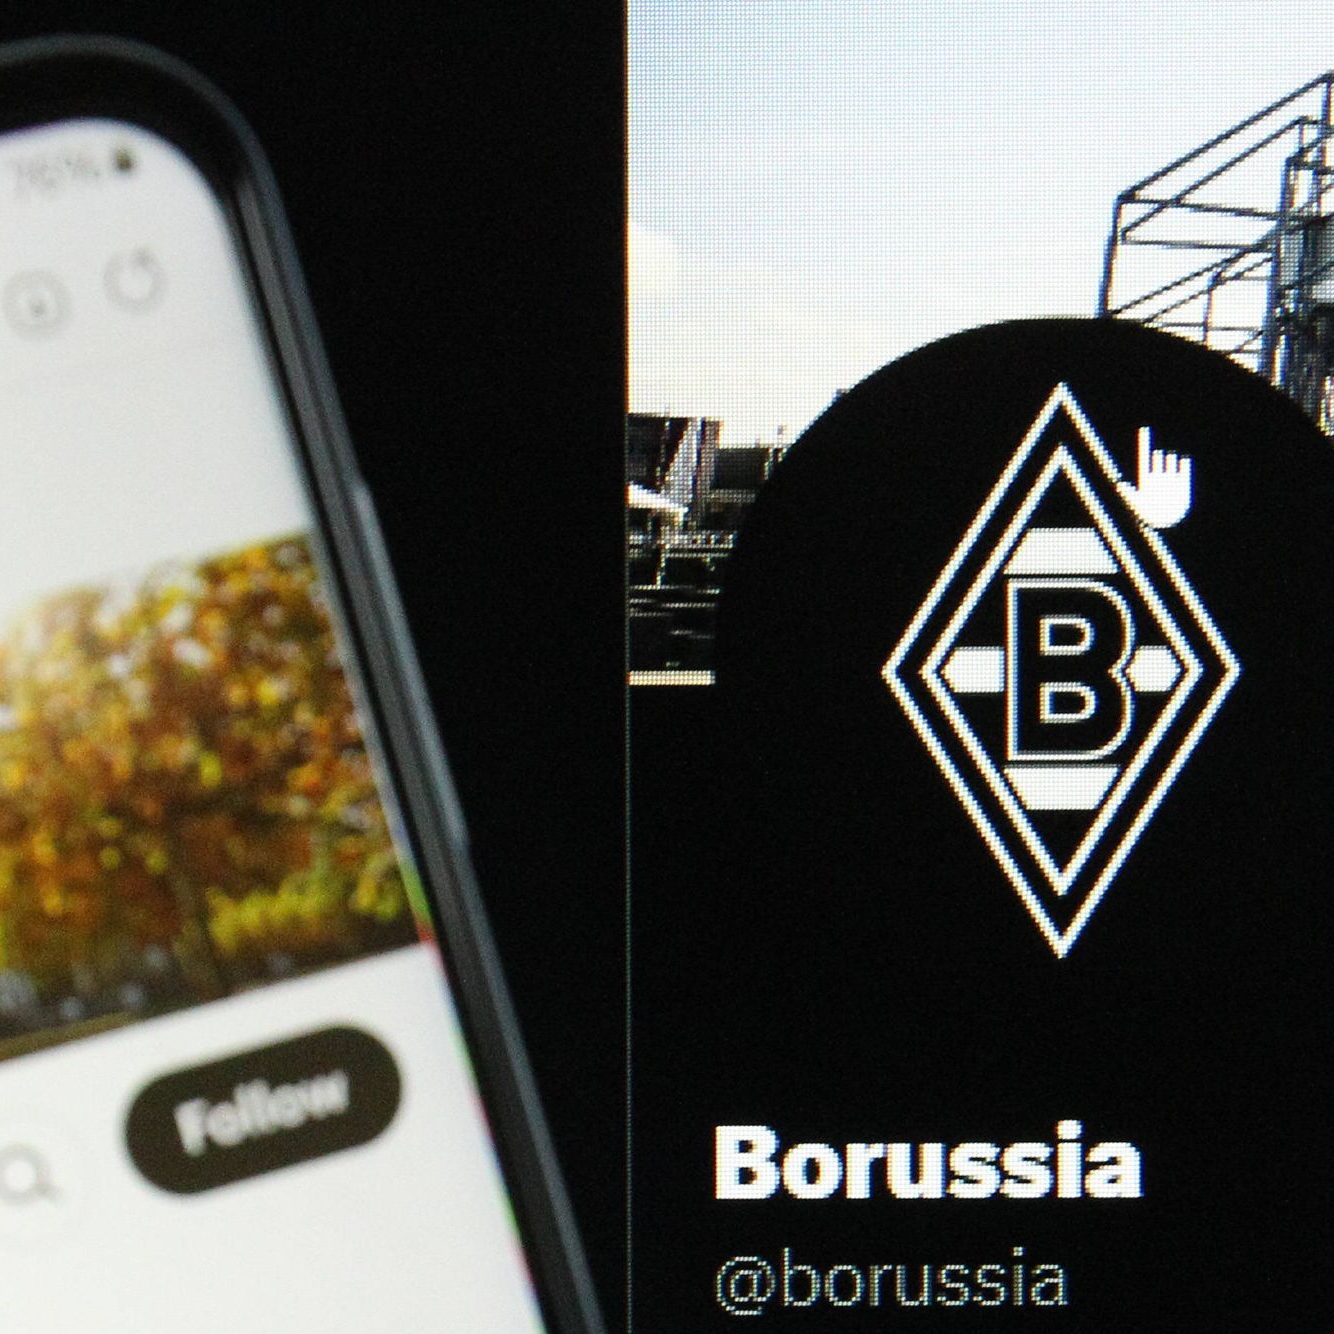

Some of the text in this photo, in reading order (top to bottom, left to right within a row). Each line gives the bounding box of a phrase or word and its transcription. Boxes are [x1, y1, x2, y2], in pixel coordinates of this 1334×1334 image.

[1005, 577, 1135, 761] B
[174, 1069, 350, 1156] Follow
[714, 1119, 1145, 1200] Borussia
[716, 1246, 1068, 1316] @borussia
